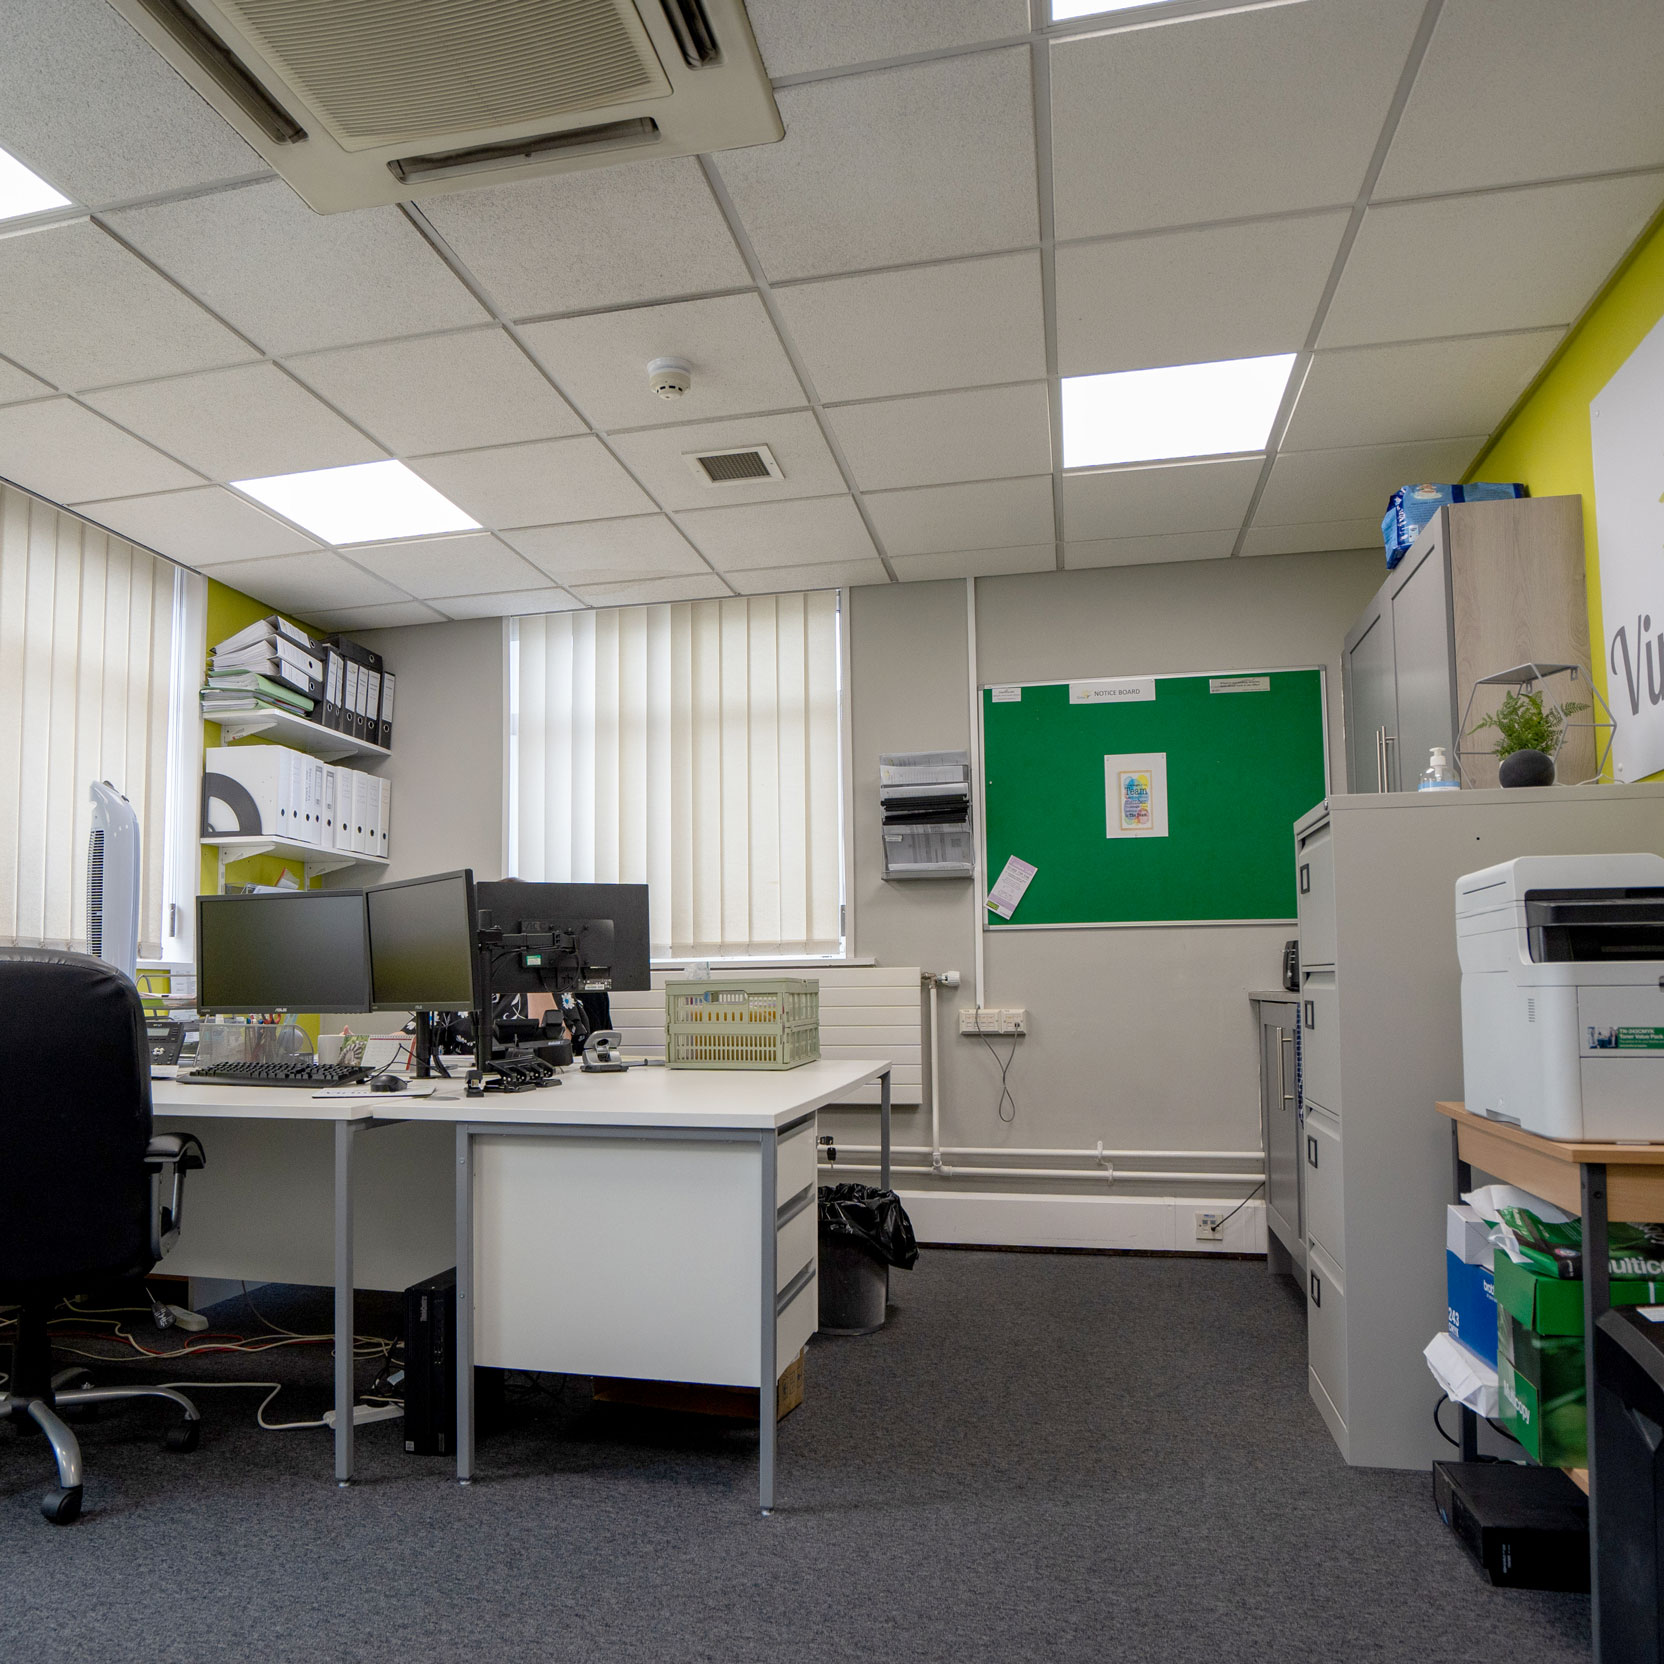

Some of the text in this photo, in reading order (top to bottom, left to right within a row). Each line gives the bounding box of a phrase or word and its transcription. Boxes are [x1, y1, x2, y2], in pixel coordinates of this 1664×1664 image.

[1118, 688, 1141, 696] BOARD
[1124, 787, 1148, 796] Team
[1608, 1256, 1664, 1275] ultic
[1448, 1307, 1460, 1327] 243
[1503, 1380, 1531, 1424] Multicopy
